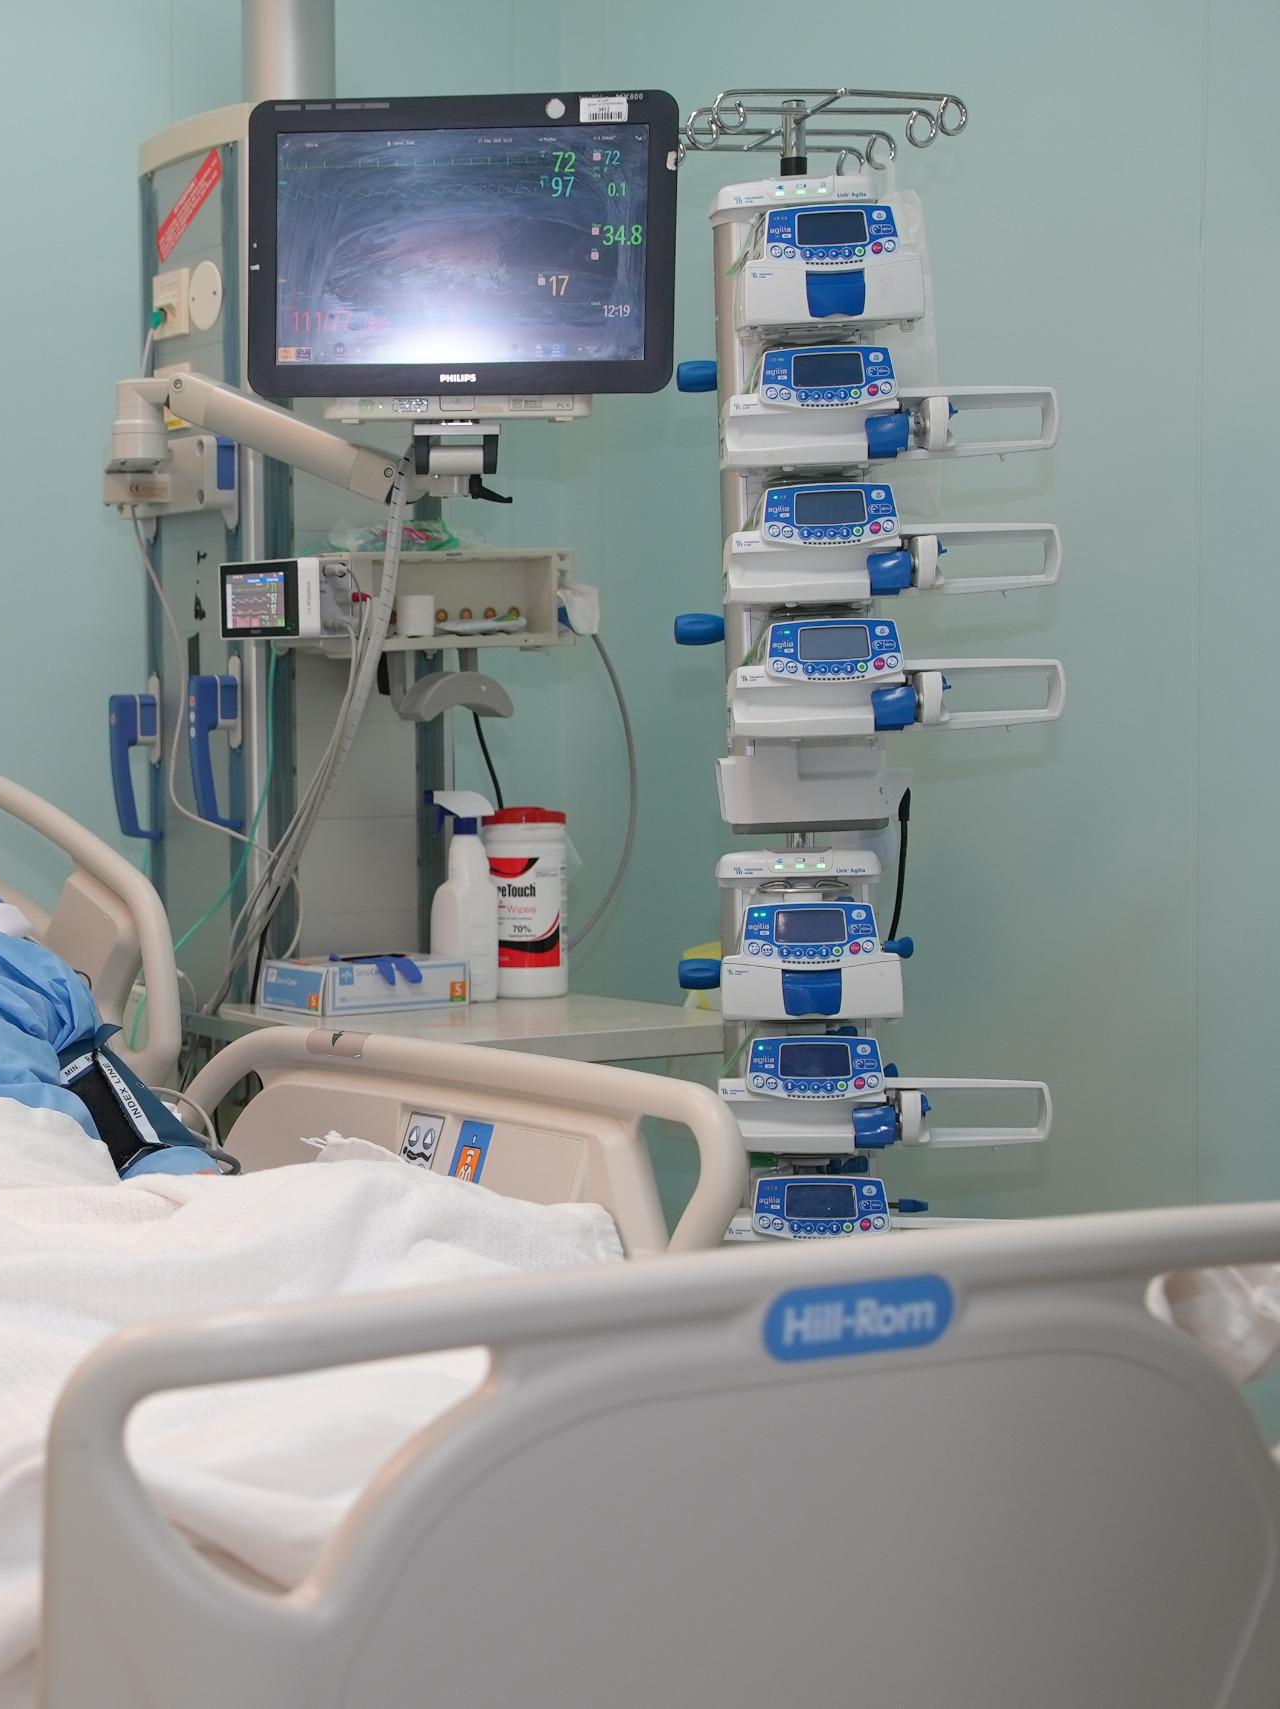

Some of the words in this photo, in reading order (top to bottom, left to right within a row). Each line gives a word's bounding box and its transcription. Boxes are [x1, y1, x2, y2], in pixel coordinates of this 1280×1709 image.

[552, 151, 576, 173] 72
[603, 150, 621, 165] 72
[551, 176, 575, 197] 97
[607, 182, 627, 197] 0.1
[602, 224, 643, 246] 34.8
[770, 225, 792, 235] agilia
[549, 275, 569, 297] 17
[602, 304, 631, 318] 12:19
[439, 373, 477, 383] PHILIPS
[497, 884, 536, 898] reTouch
[507, 904, 536, 915] Wipes
[512, 925, 532, 933] 70%
[748, 922, 770, 932] agilia
[454, 982, 462, 997] S
[102, 1062, 121, 1084] LINE
[120, 1086, 143, 1119] INDEX
[781, 1297, 937, 1346] Hill-Rom
